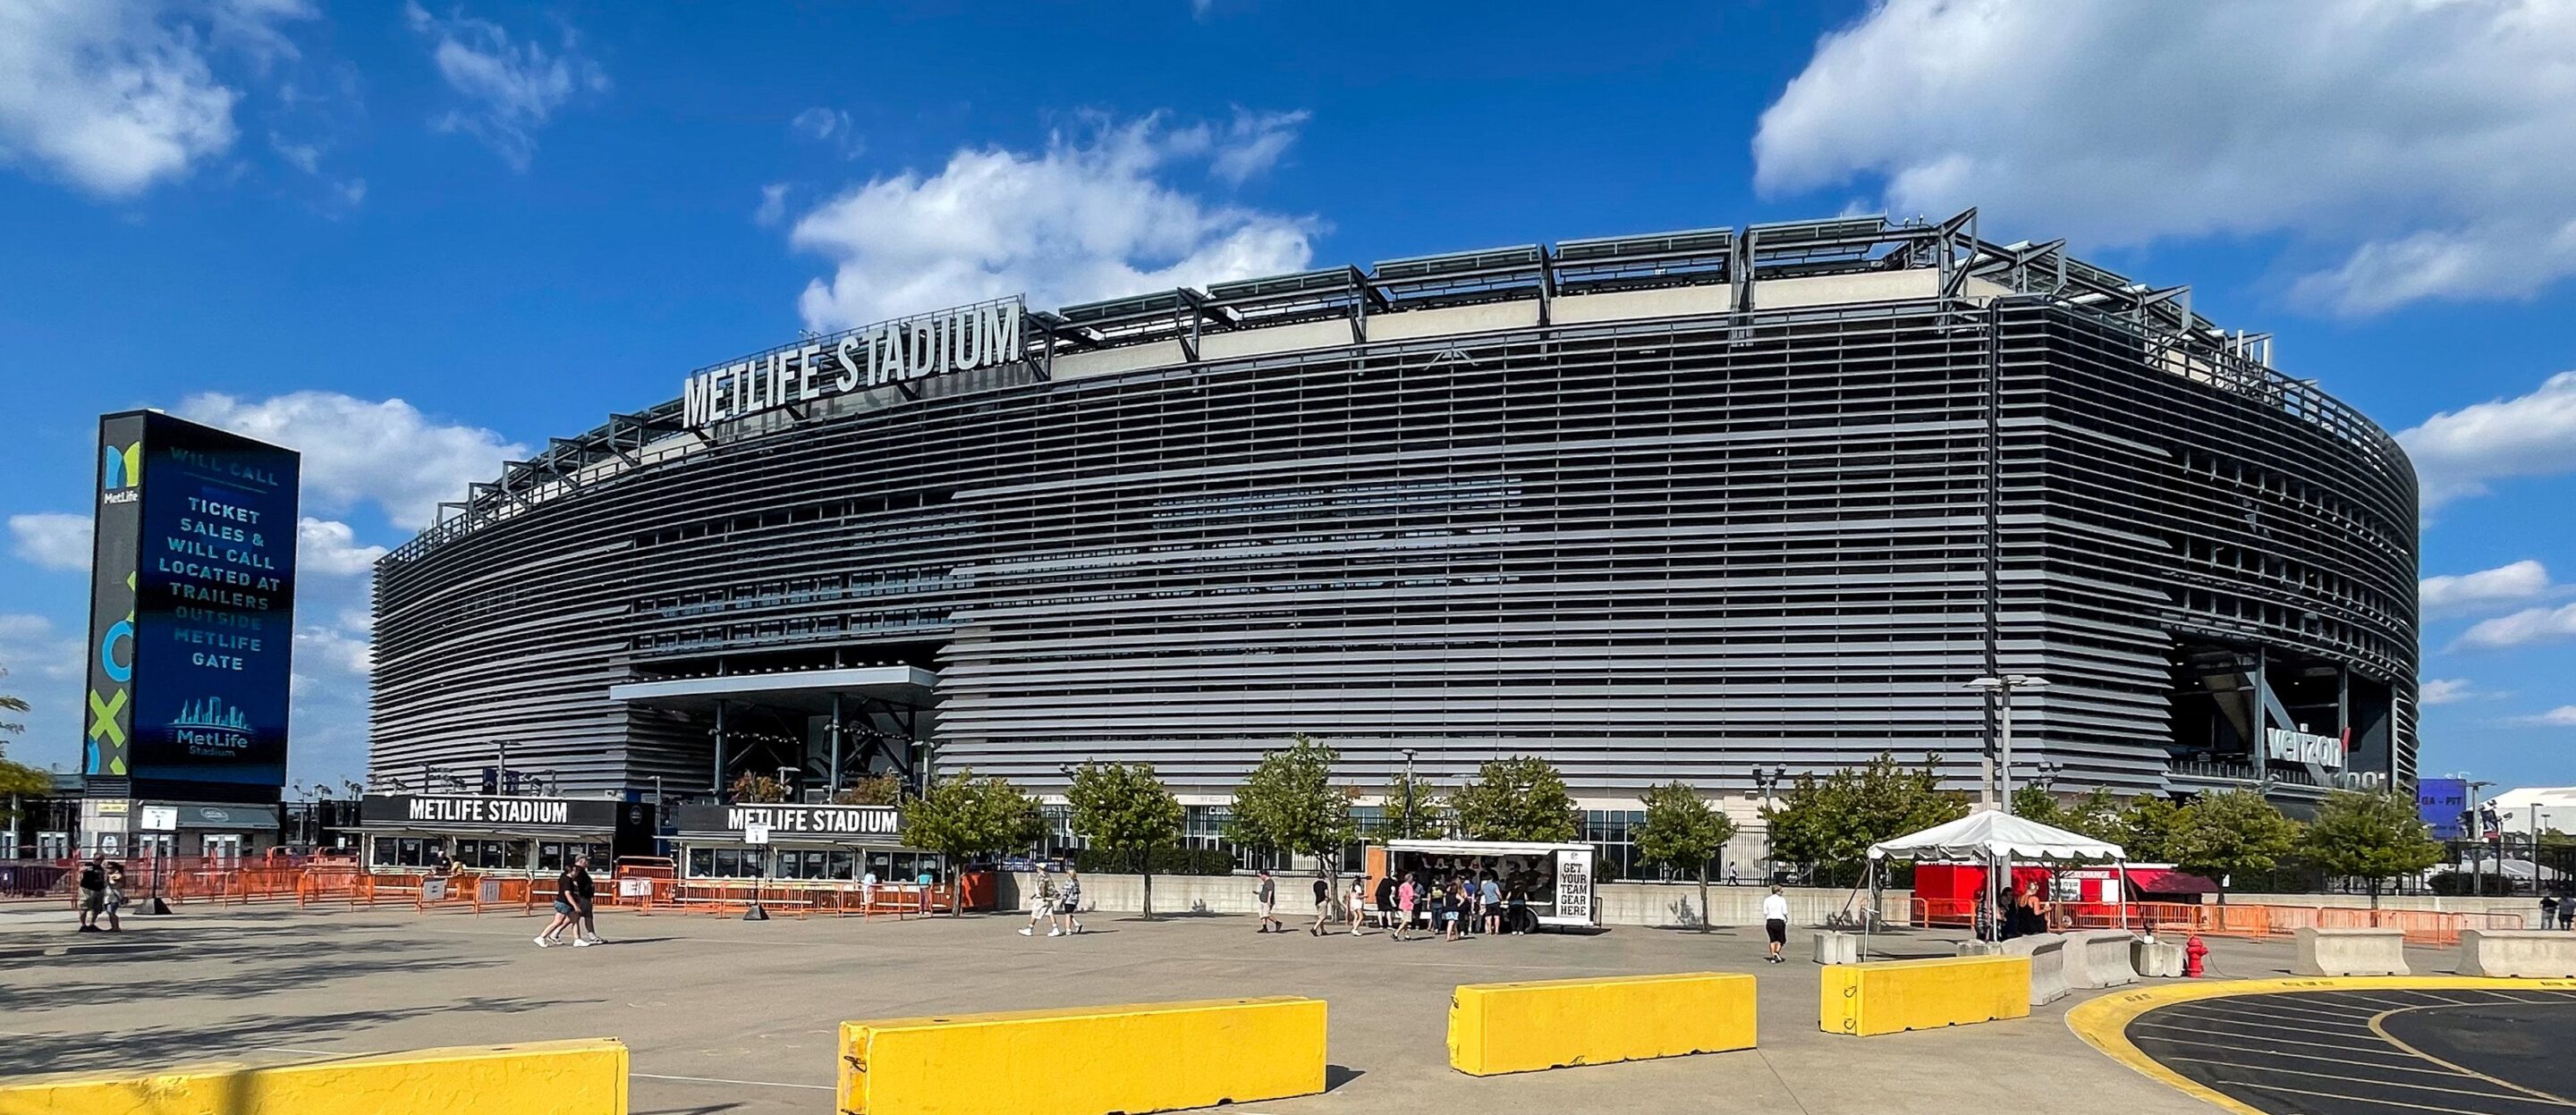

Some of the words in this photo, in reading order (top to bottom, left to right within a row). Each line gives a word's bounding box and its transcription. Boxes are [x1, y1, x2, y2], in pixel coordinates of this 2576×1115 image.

[683, 344, 821, 429] METLIFE
[835, 302, 1021, 393] STADIUM
[170, 447, 222, 471] WILL
[230, 462, 278, 486] CALL
[104, 491, 138, 503] MetLife
[188, 496, 260, 524] TICKET
[181, 518, 244, 543] SALES
[252, 533, 264, 546] &
[167, 536, 218, 559] WILL
[226, 549, 275, 570] CALL
[159, 557, 250, 586] LOCATED
[258, 577, 280, 591] AT
[170, 582, 267, 610] TRAILERS
[175, 605, 261, 630] OUTSIDE
[174, 628, 261, 652] METLIFE
[192, 652, 242, 671] GATE
[177, 730, 248, 748] MetLife
[189, 746, 235, 756] Stadium
[2267, 722, 2342, 767] verizon
[409, 798, 483, 821] METLIFE
[488, 800, 567, 824] STADIUM
[728, 808, 807, 832] METLIFE
[812, 810, 897, 832] STADIUM
[1562, 874, 1587, 883] YOUR
[1563, 863, 1582, 873] GET
[1561, 884, 1587, 894] TEAM
[1561, 895, 1586, 905] GEAR
[1561, 905, 1586, 916] HERE
